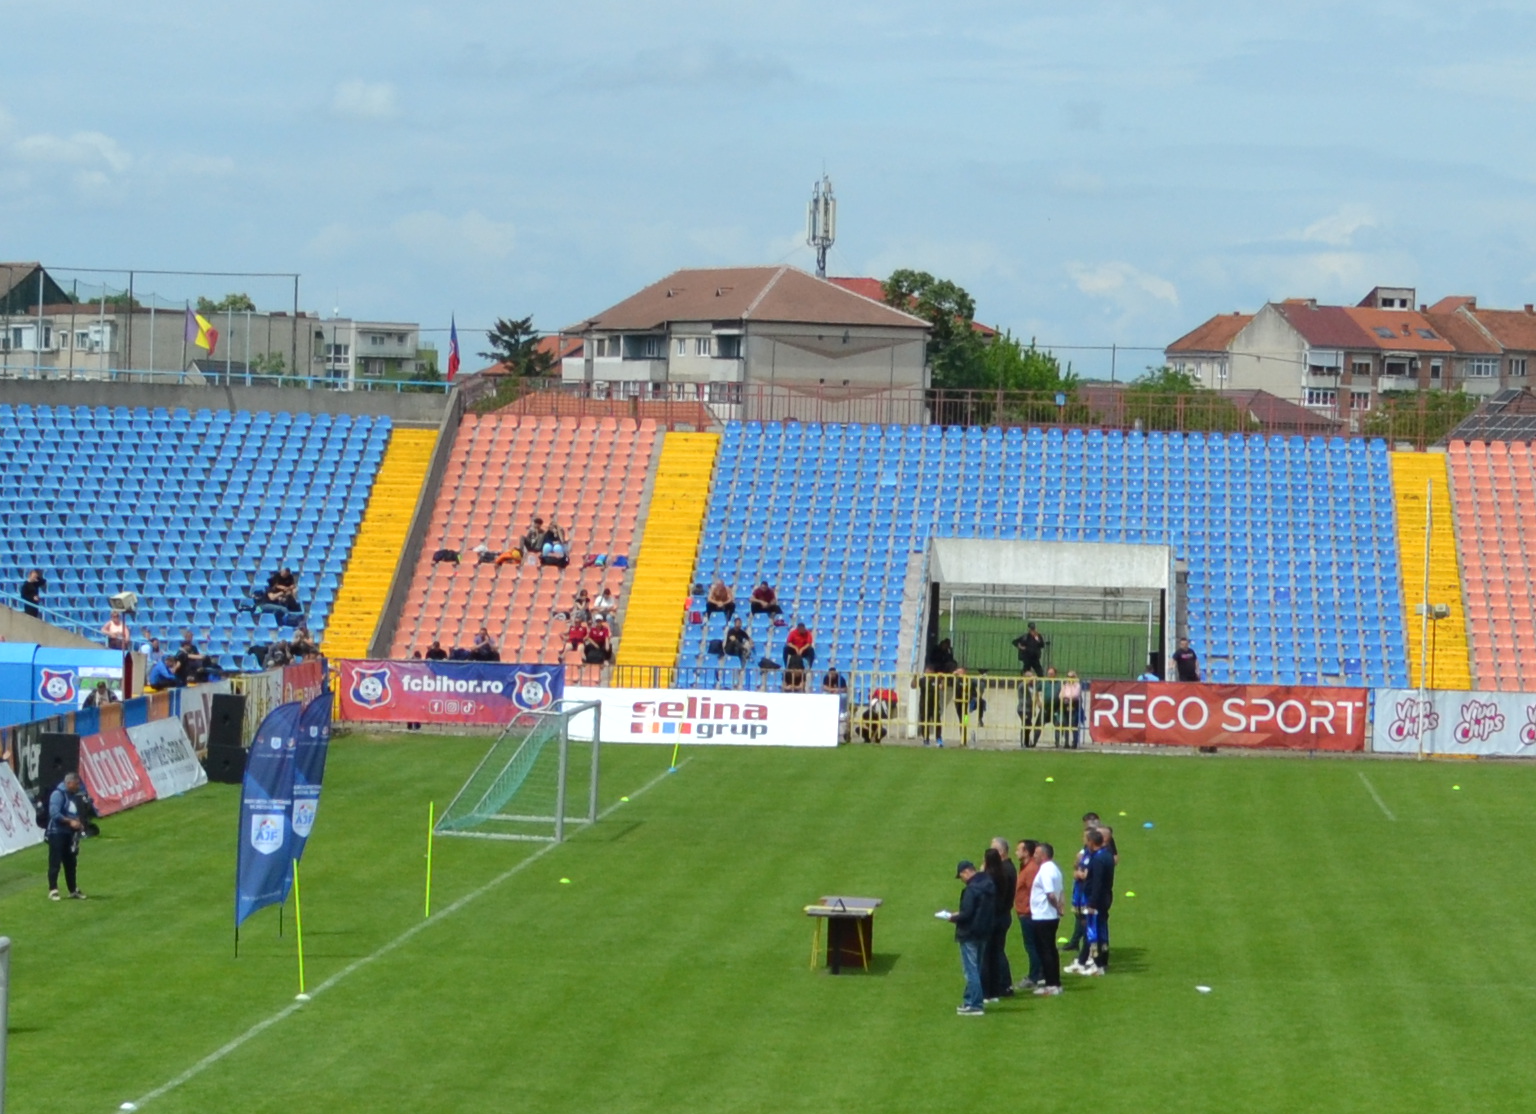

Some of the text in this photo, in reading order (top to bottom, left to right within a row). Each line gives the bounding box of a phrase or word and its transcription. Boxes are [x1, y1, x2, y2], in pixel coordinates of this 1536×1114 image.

[402, 674, 503, 694] fcbihor.ro
[632, 697, 768, 720] selina
[1093, 693, 1363, 735] RECO SPORT
[1396, 698, 1431, 719] Viva
[1462, 700, 1497, 721] Viva
[697, 723, 768, 739] grup
[1389, 712, 1439, 742] Chips
[1454, 714, 1505, 744] Chips
[255, 833, 278, 841] AJF
